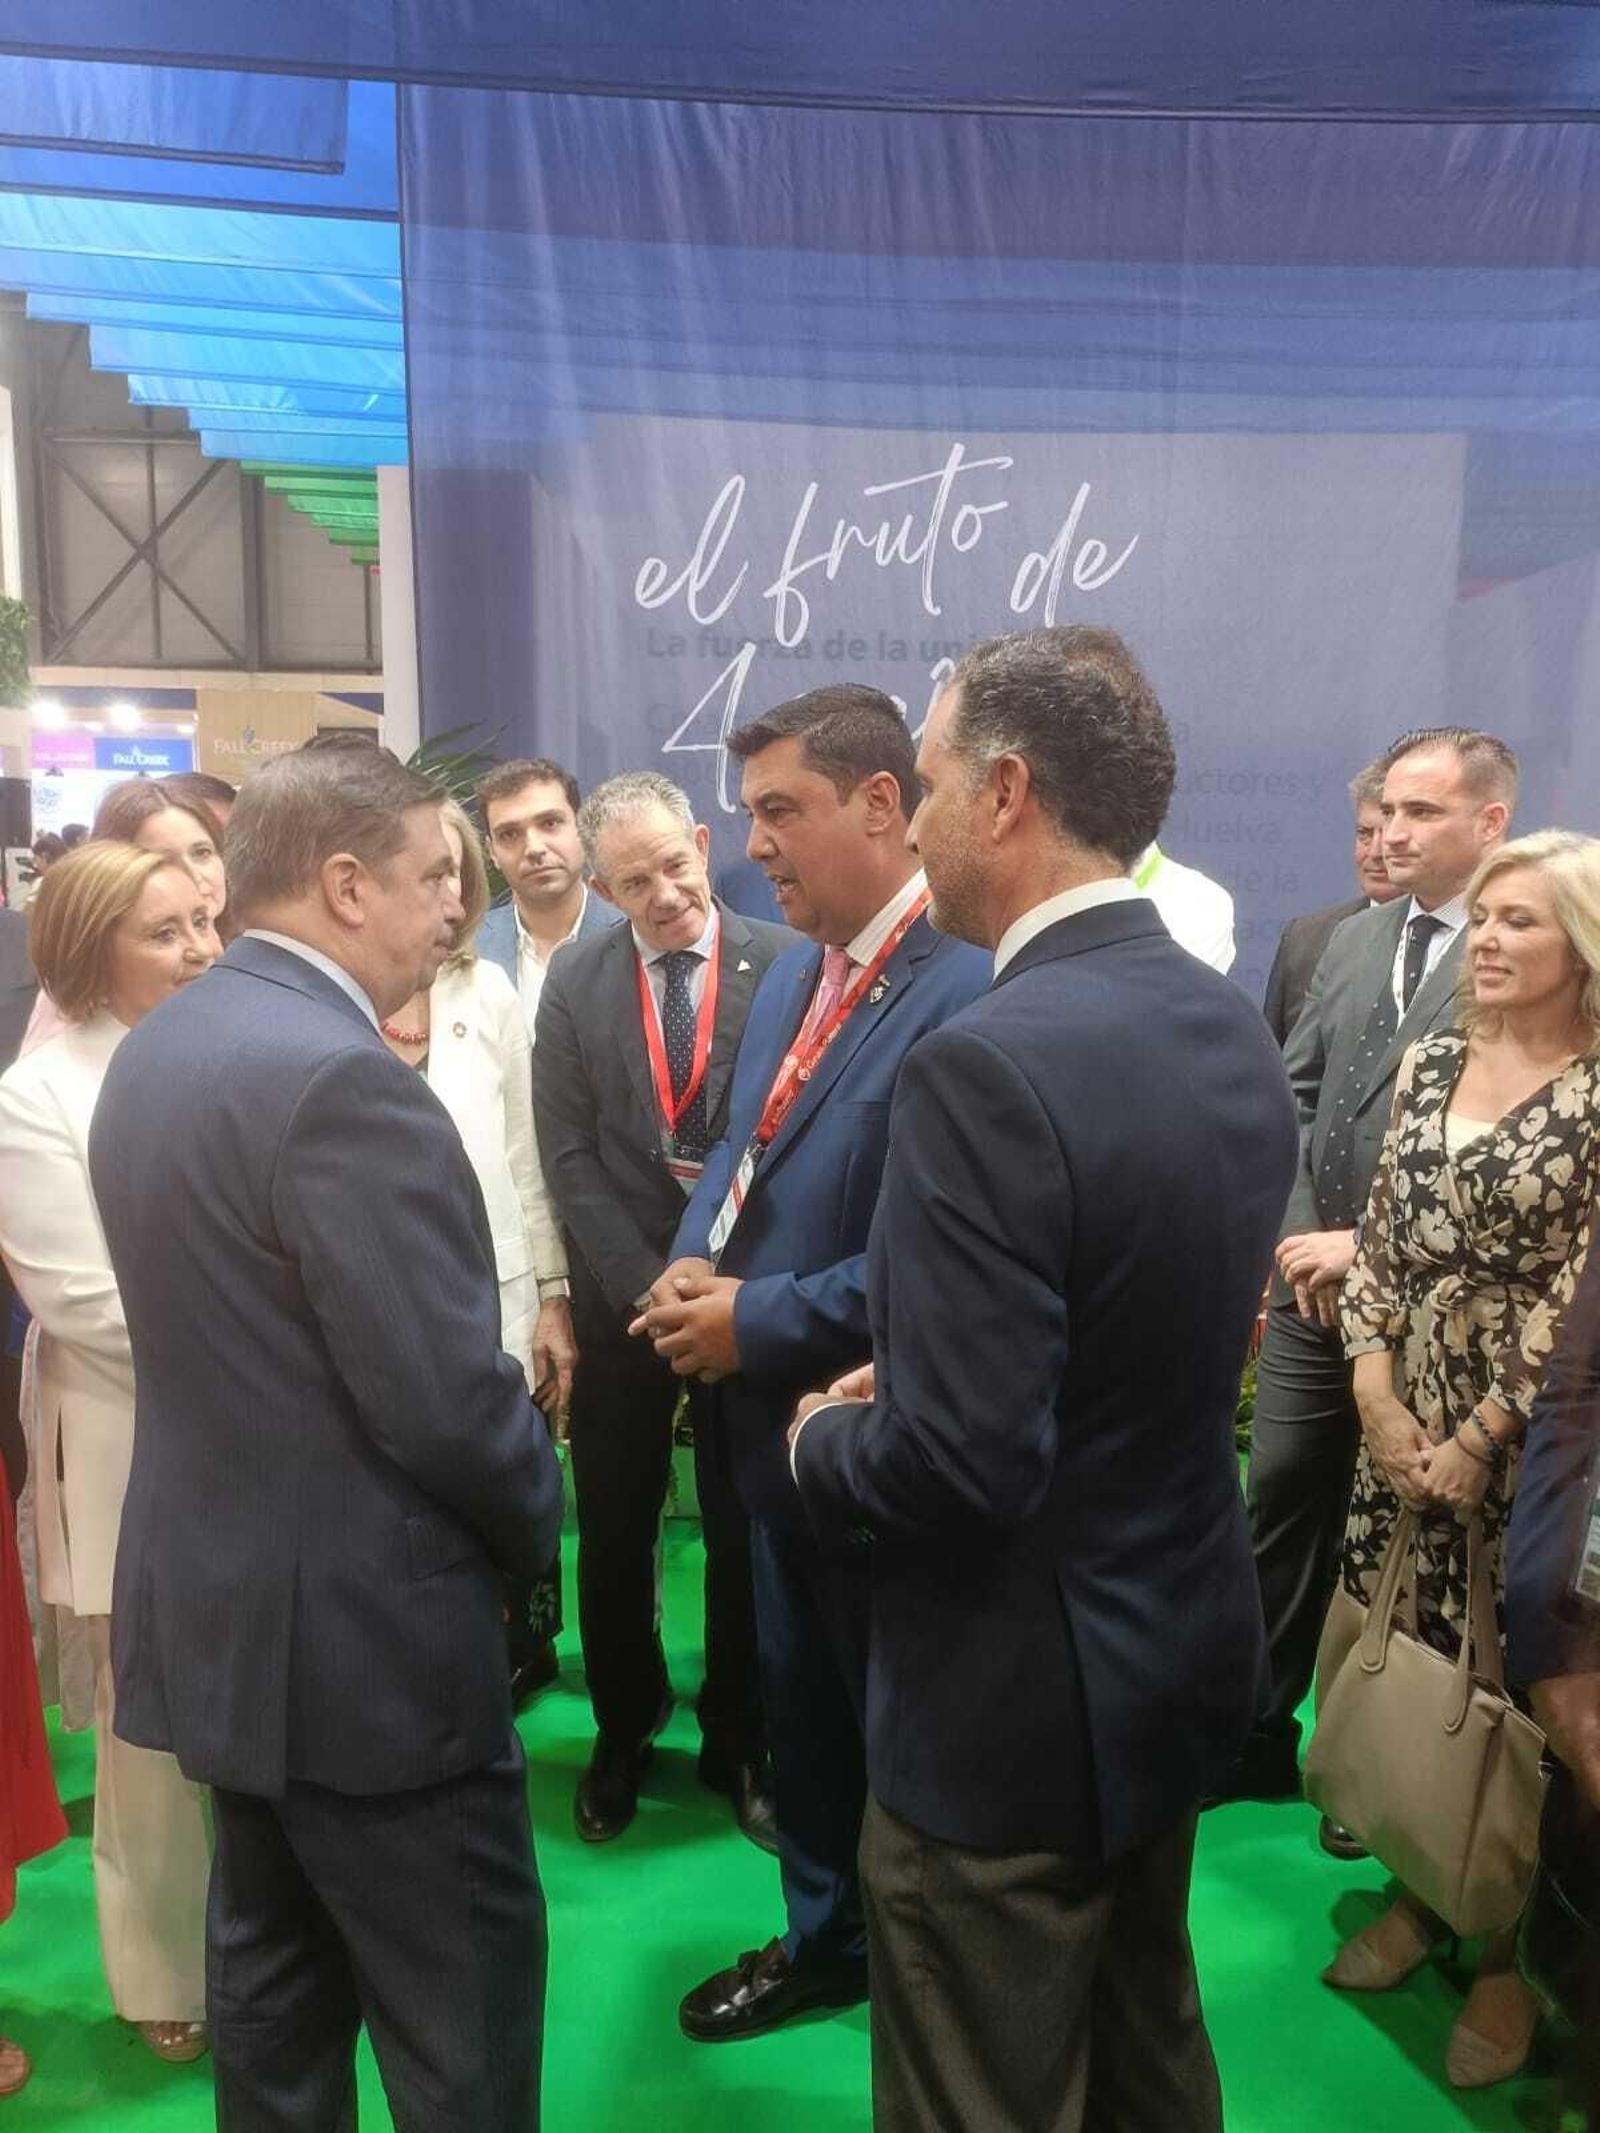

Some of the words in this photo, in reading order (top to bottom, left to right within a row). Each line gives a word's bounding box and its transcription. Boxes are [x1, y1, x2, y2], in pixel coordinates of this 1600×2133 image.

[634, 475, 748, 626] el
[763, 442, 1014, 648] fruto
[1010, 481, 1140, 629] de
[648, 628, 686, 658] La
[825, 630, 867, 660] de
[880, 630, 913, 660] la
[660, 641, 757, 814] 4
